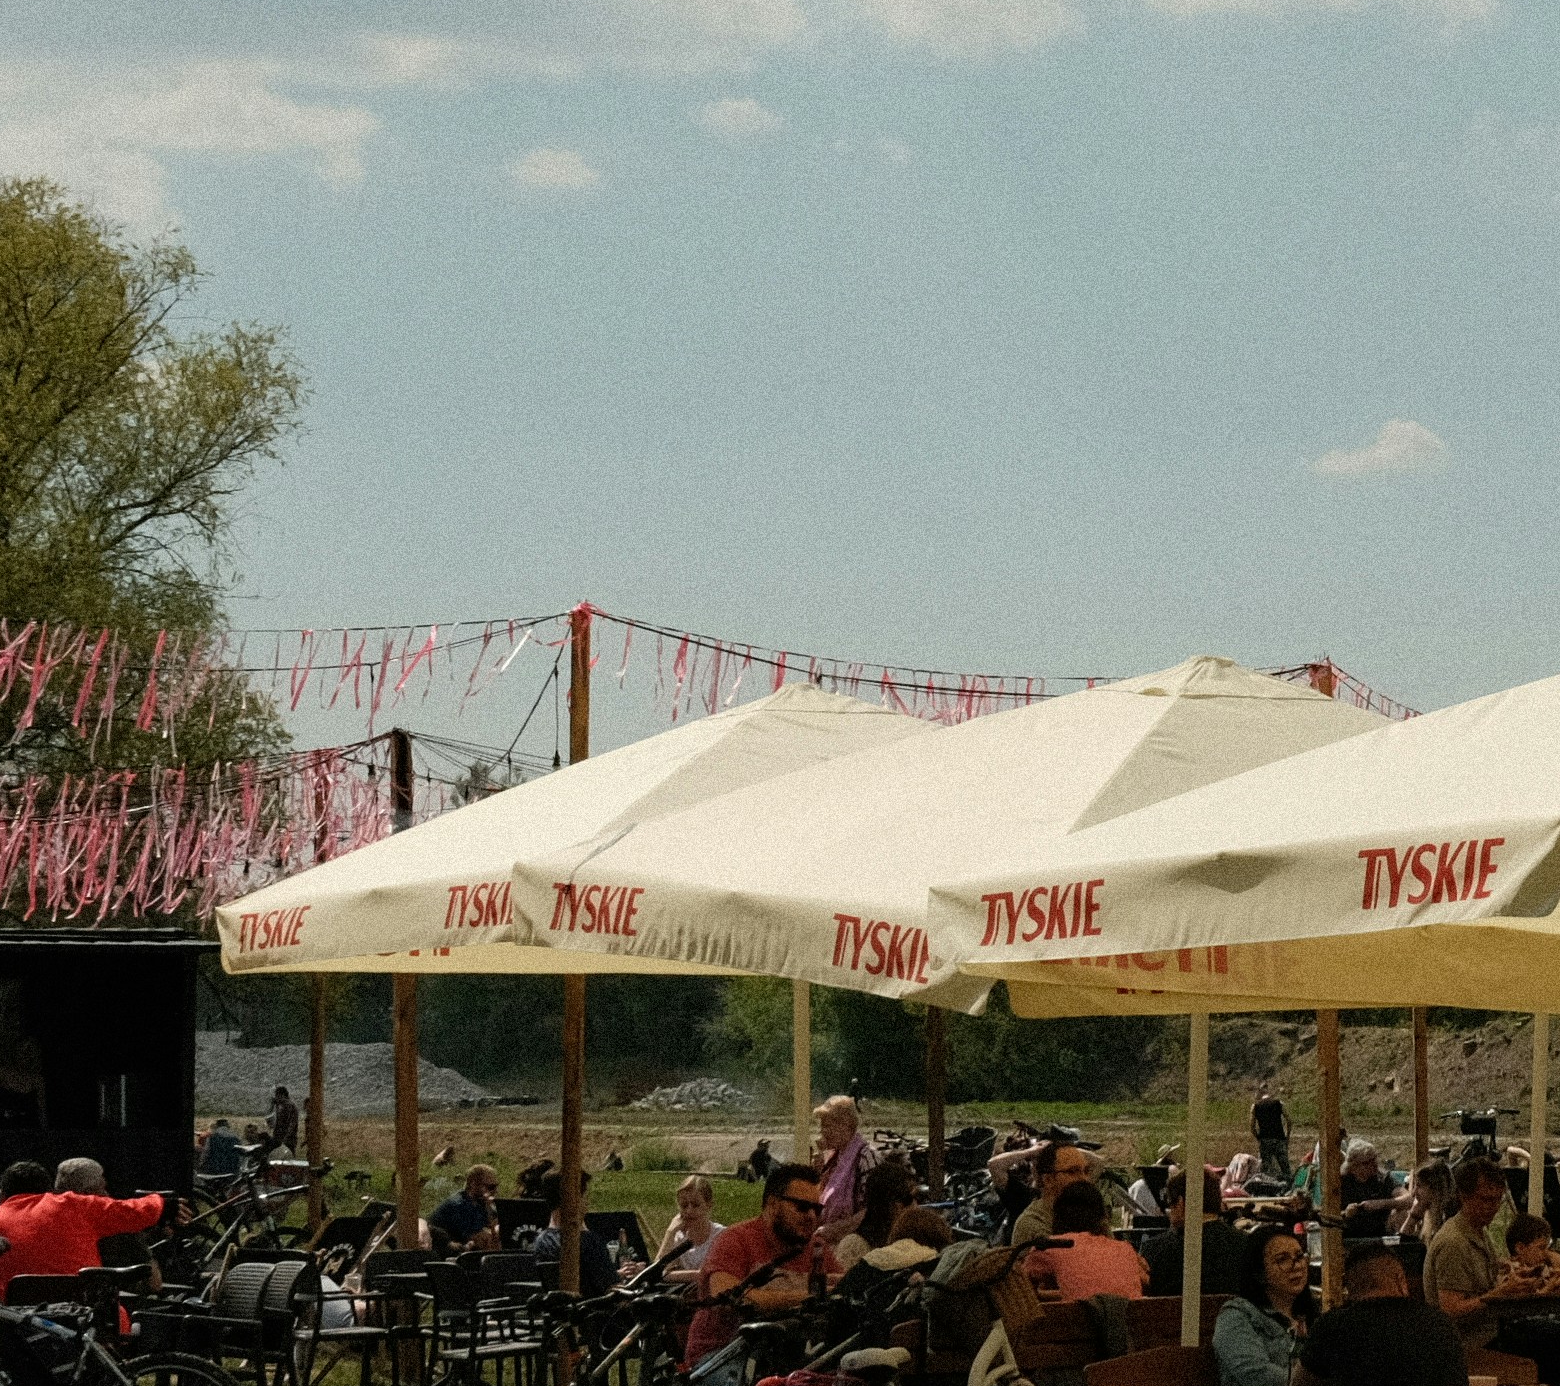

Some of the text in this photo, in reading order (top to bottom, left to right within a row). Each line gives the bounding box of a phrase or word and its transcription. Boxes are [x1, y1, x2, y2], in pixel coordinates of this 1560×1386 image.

[1357, 838, 1505, 910] TYSKIE
[239, 905, 311, 953] TYSKIE
[549, 883, 645, 937] TYSKIE
[980, 879, 1105, 946] TYSKIE
